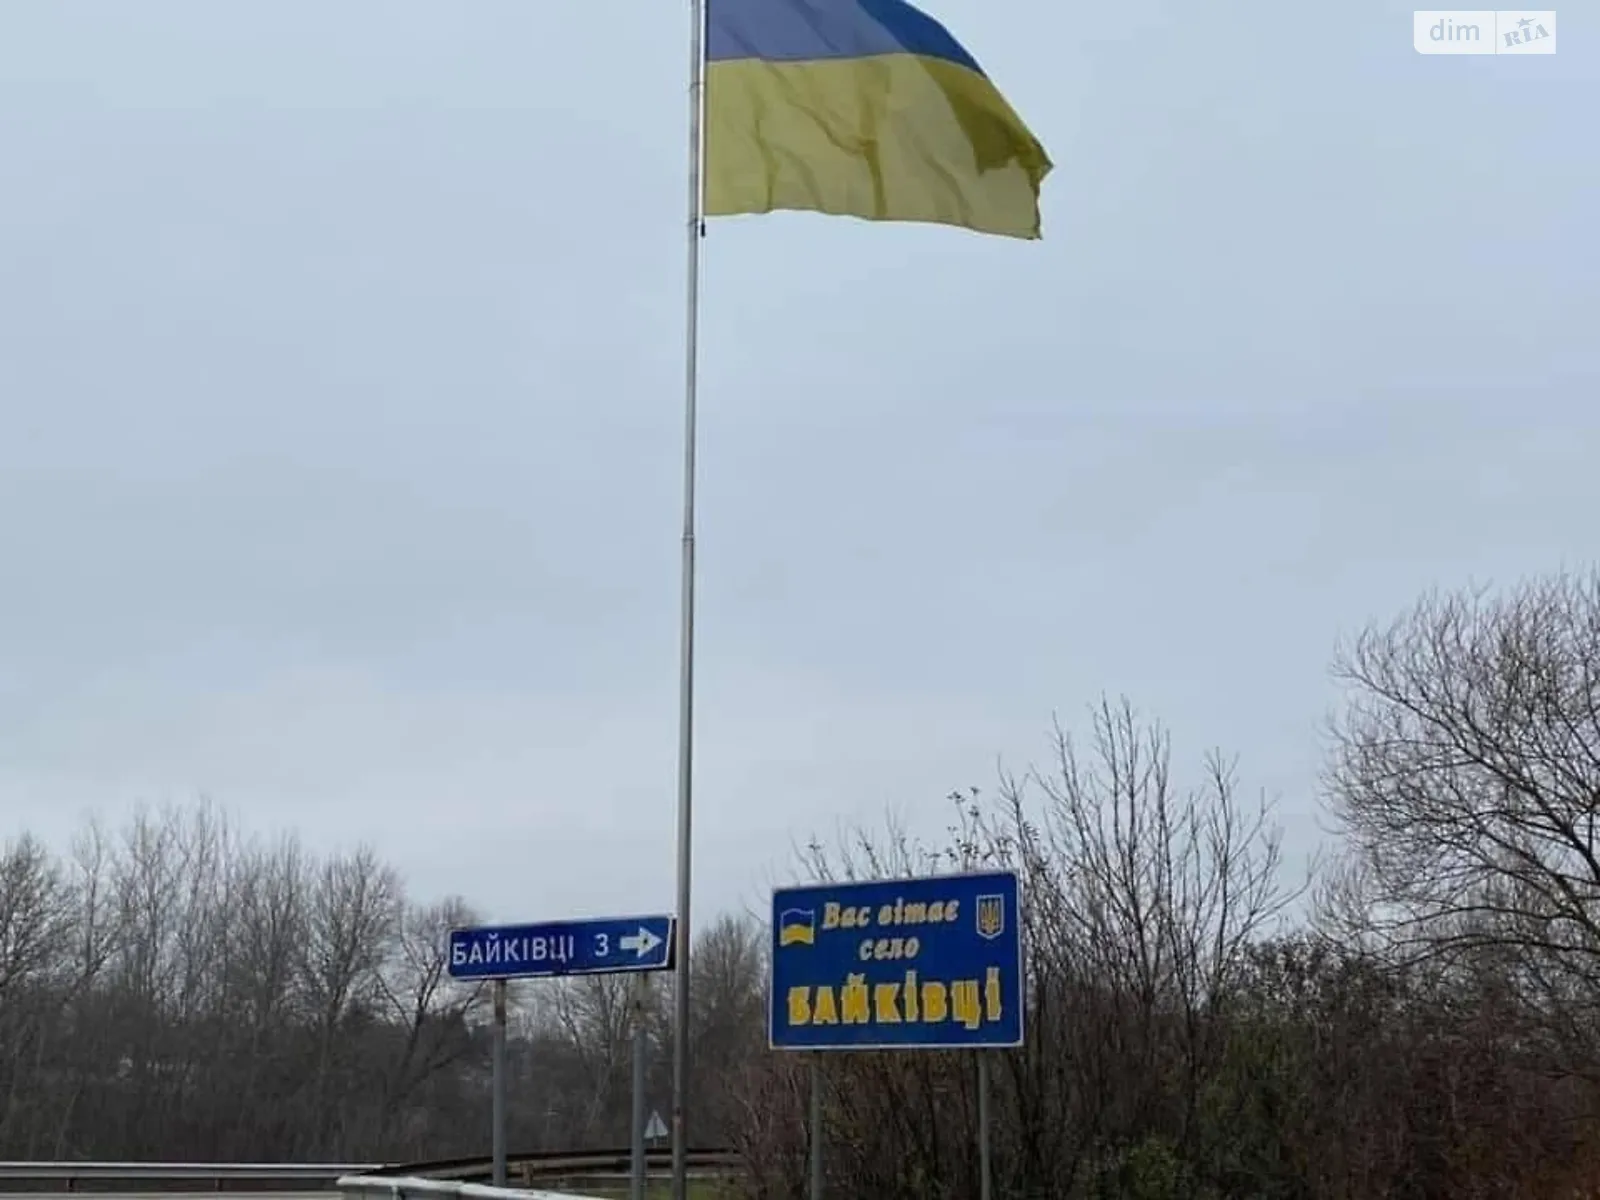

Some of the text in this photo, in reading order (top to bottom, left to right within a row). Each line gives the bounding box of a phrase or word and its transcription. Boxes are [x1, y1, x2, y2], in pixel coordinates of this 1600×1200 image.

[822, 897, 960, 929] Вас вітає
[452, 933, 609, 965] БАЙКІВЦІ 3
[859, 937, 920, 961] село
[788, 967, 1002, 1030] БАЙКІВЦІ
